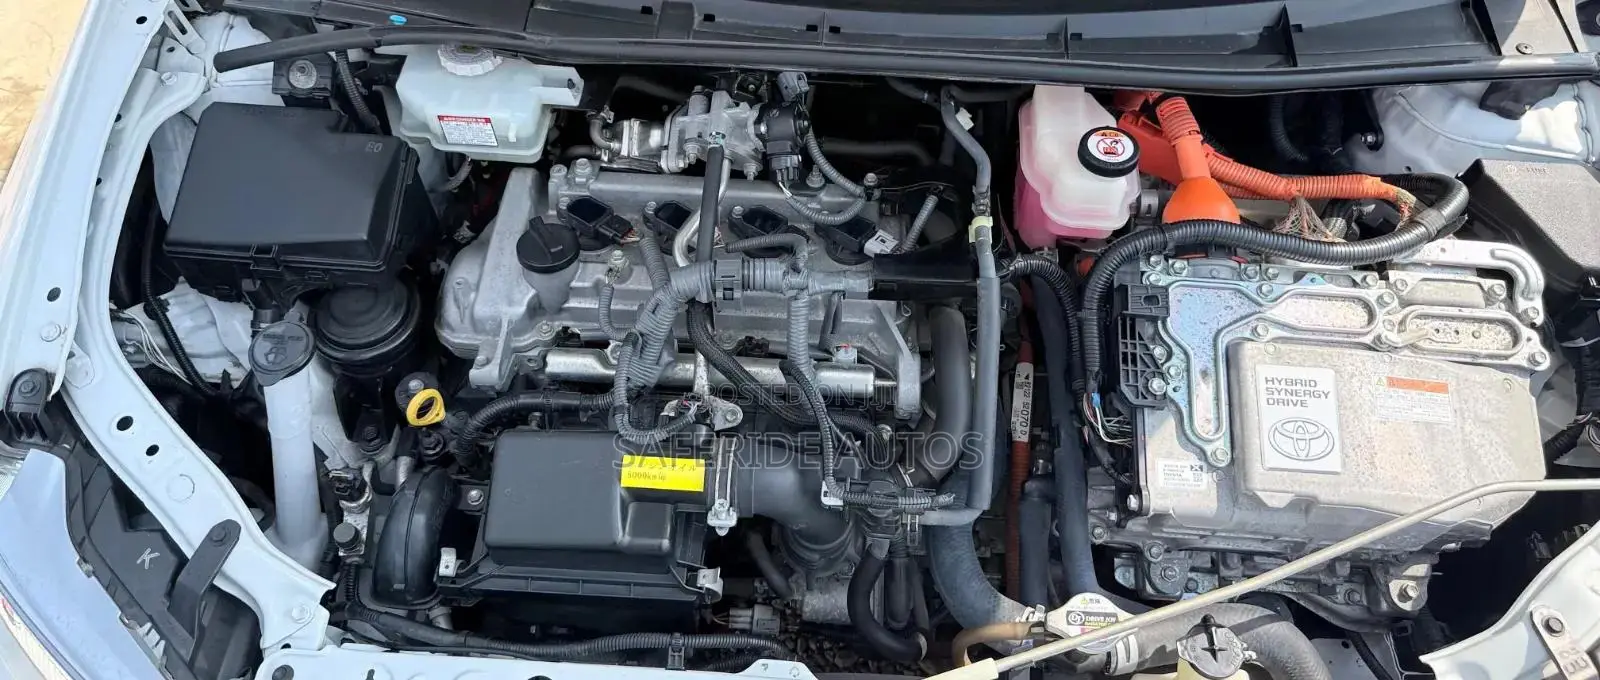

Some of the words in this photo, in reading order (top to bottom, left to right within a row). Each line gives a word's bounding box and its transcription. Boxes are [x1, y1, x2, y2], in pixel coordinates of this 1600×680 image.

[1264, 376, 1317, 388] HYBRID
[1265, 387, 1331, 399] SYNERGY
[1266, 397, 1309, 408] DRIVE
[136, 547, 161, 570] K
